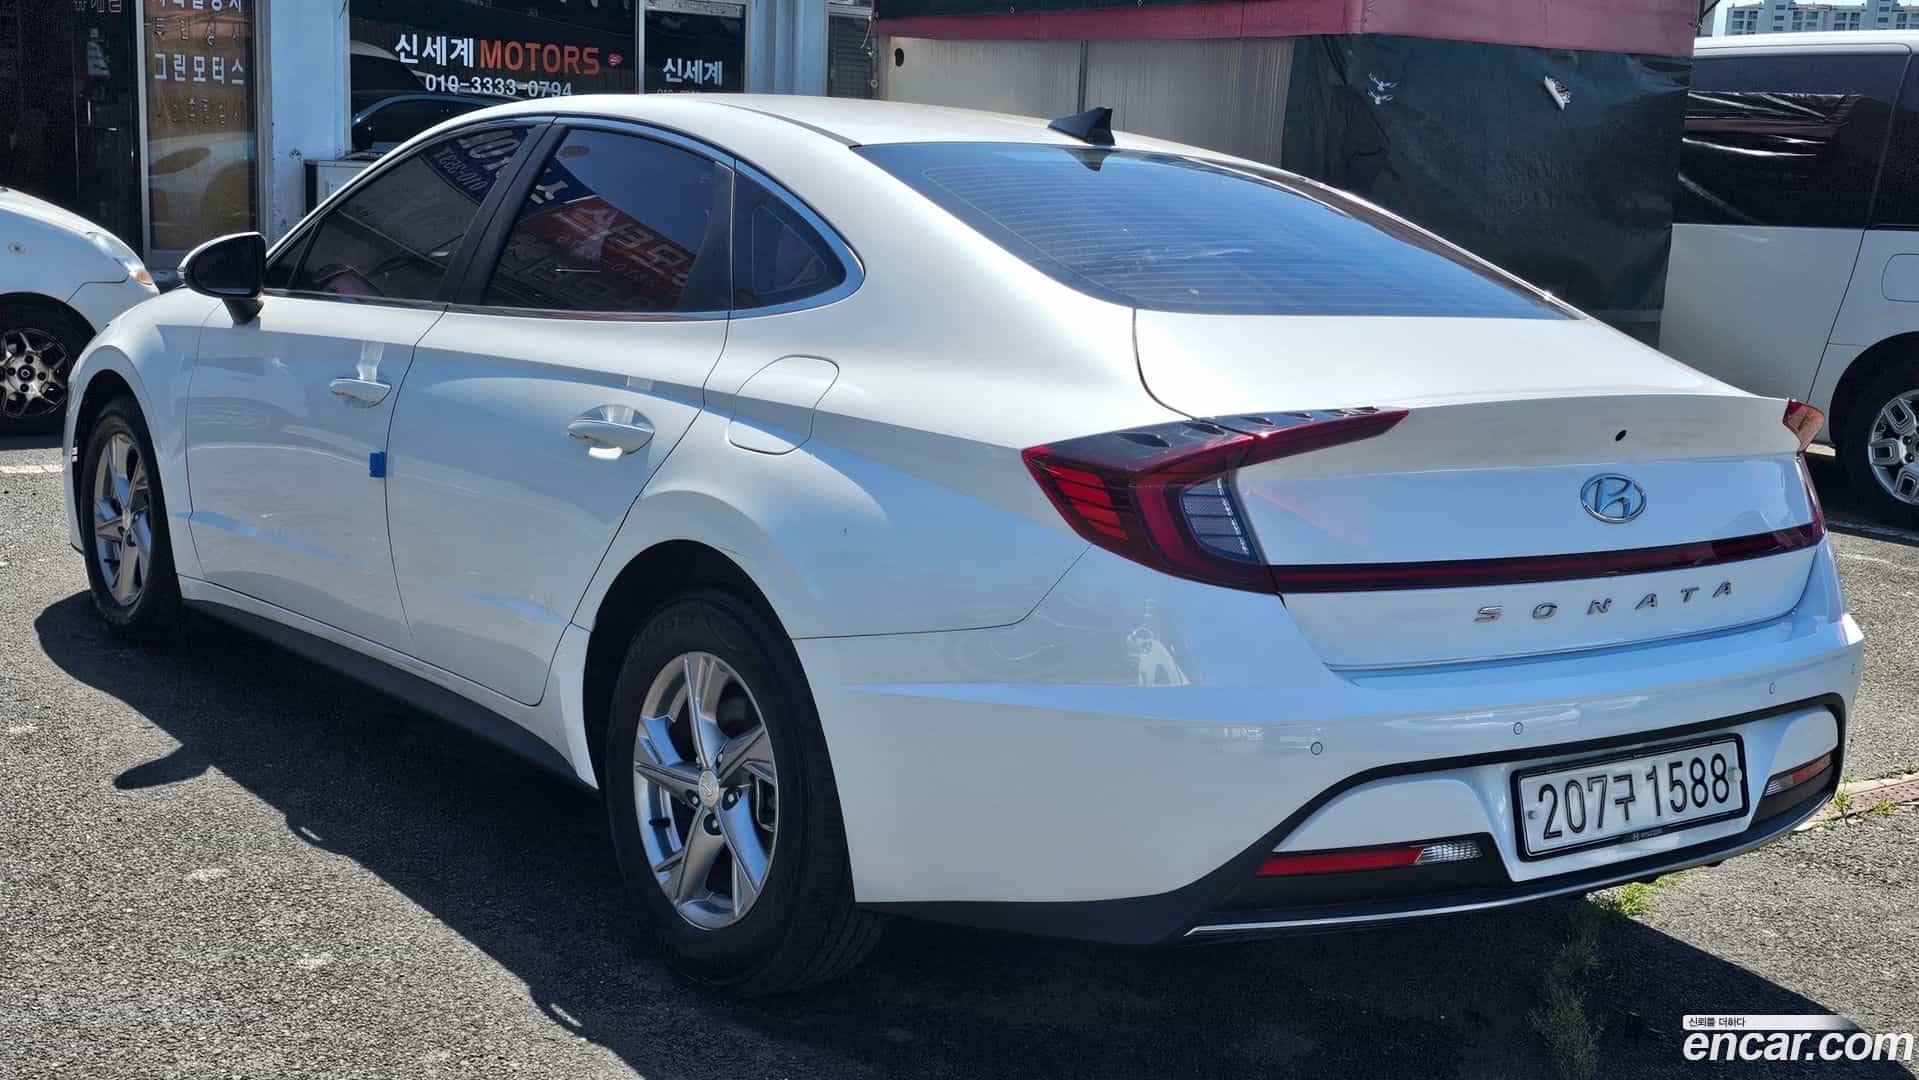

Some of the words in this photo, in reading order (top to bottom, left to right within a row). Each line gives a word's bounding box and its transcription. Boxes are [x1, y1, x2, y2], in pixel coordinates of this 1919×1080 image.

[154, 53, 244, 84] 그린모터스
[394, 33, 474, 67] 신세계
[479, 39, 600, 75] MOTORS
[662, 57, 723, 86] 신세계
[425, 74, 572, 97] 010-3333-0794
[1475, 580, 1733, 622] SONATA
[1645, 753, 1730, 818] 1588
